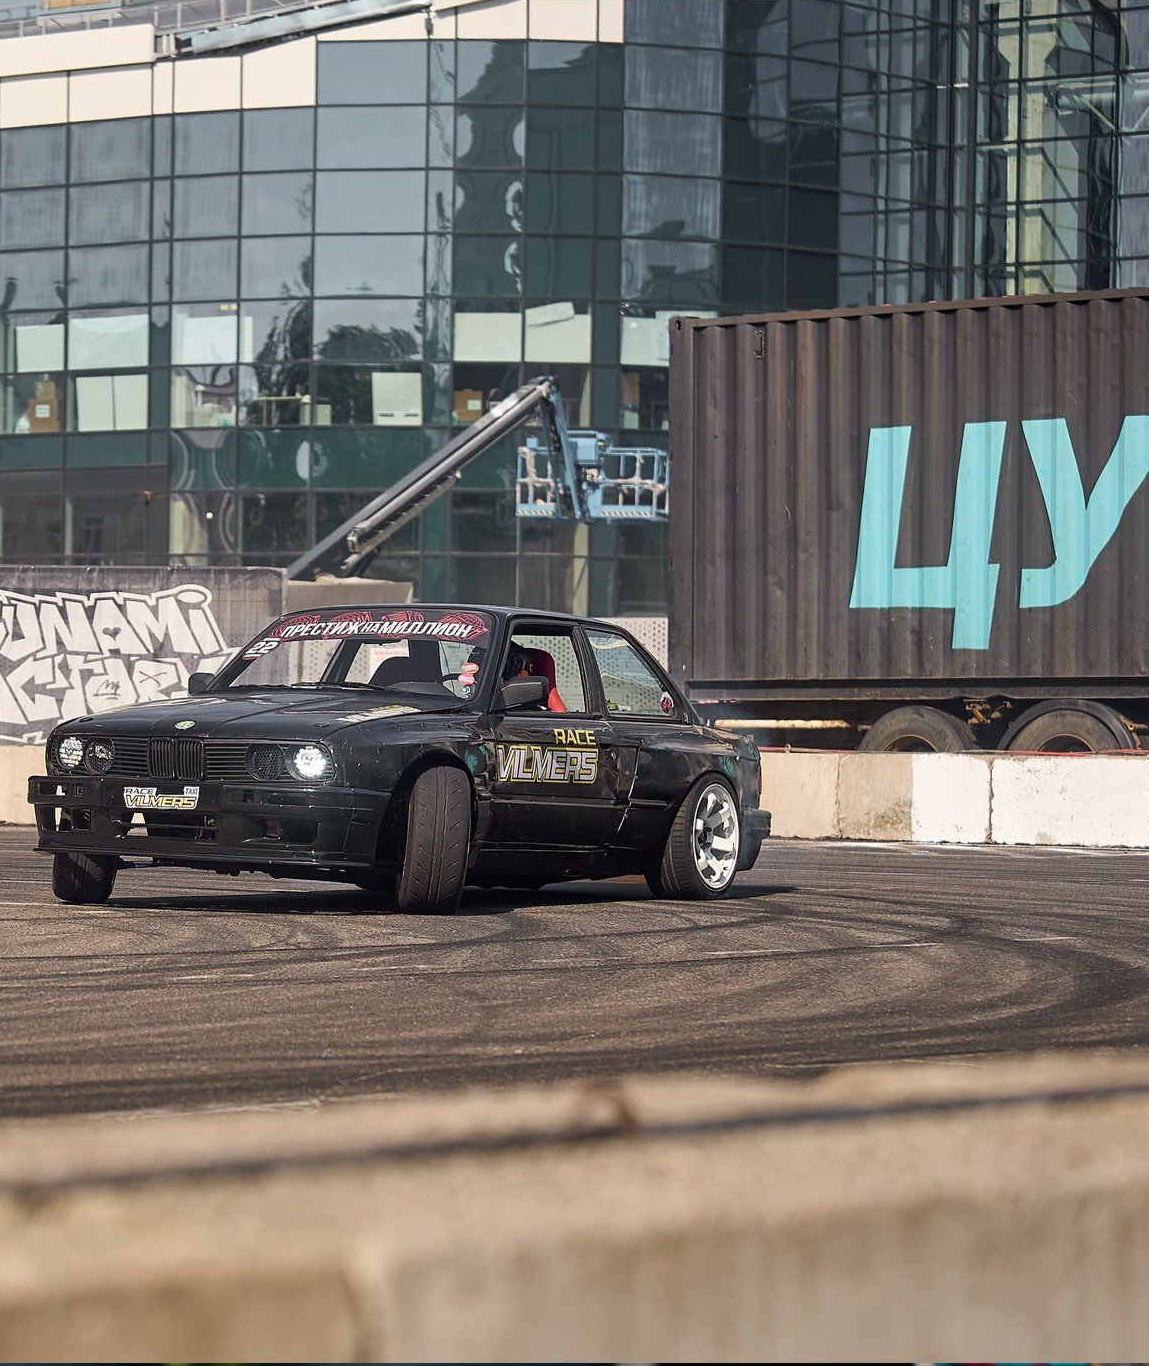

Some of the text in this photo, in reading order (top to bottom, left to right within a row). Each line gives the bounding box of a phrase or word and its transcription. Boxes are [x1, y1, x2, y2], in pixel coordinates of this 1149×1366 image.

[280, 621, 362, 637] ПРЕСТИЖ
[377, 621, 473, 638] МИЛЛИОН
[245, 641, 280, 654] 22
[554, 728, 597, 745] RACE
[495, 743, 599, 784] VILMERS
[126, 795, 197, 808] VILMERS
